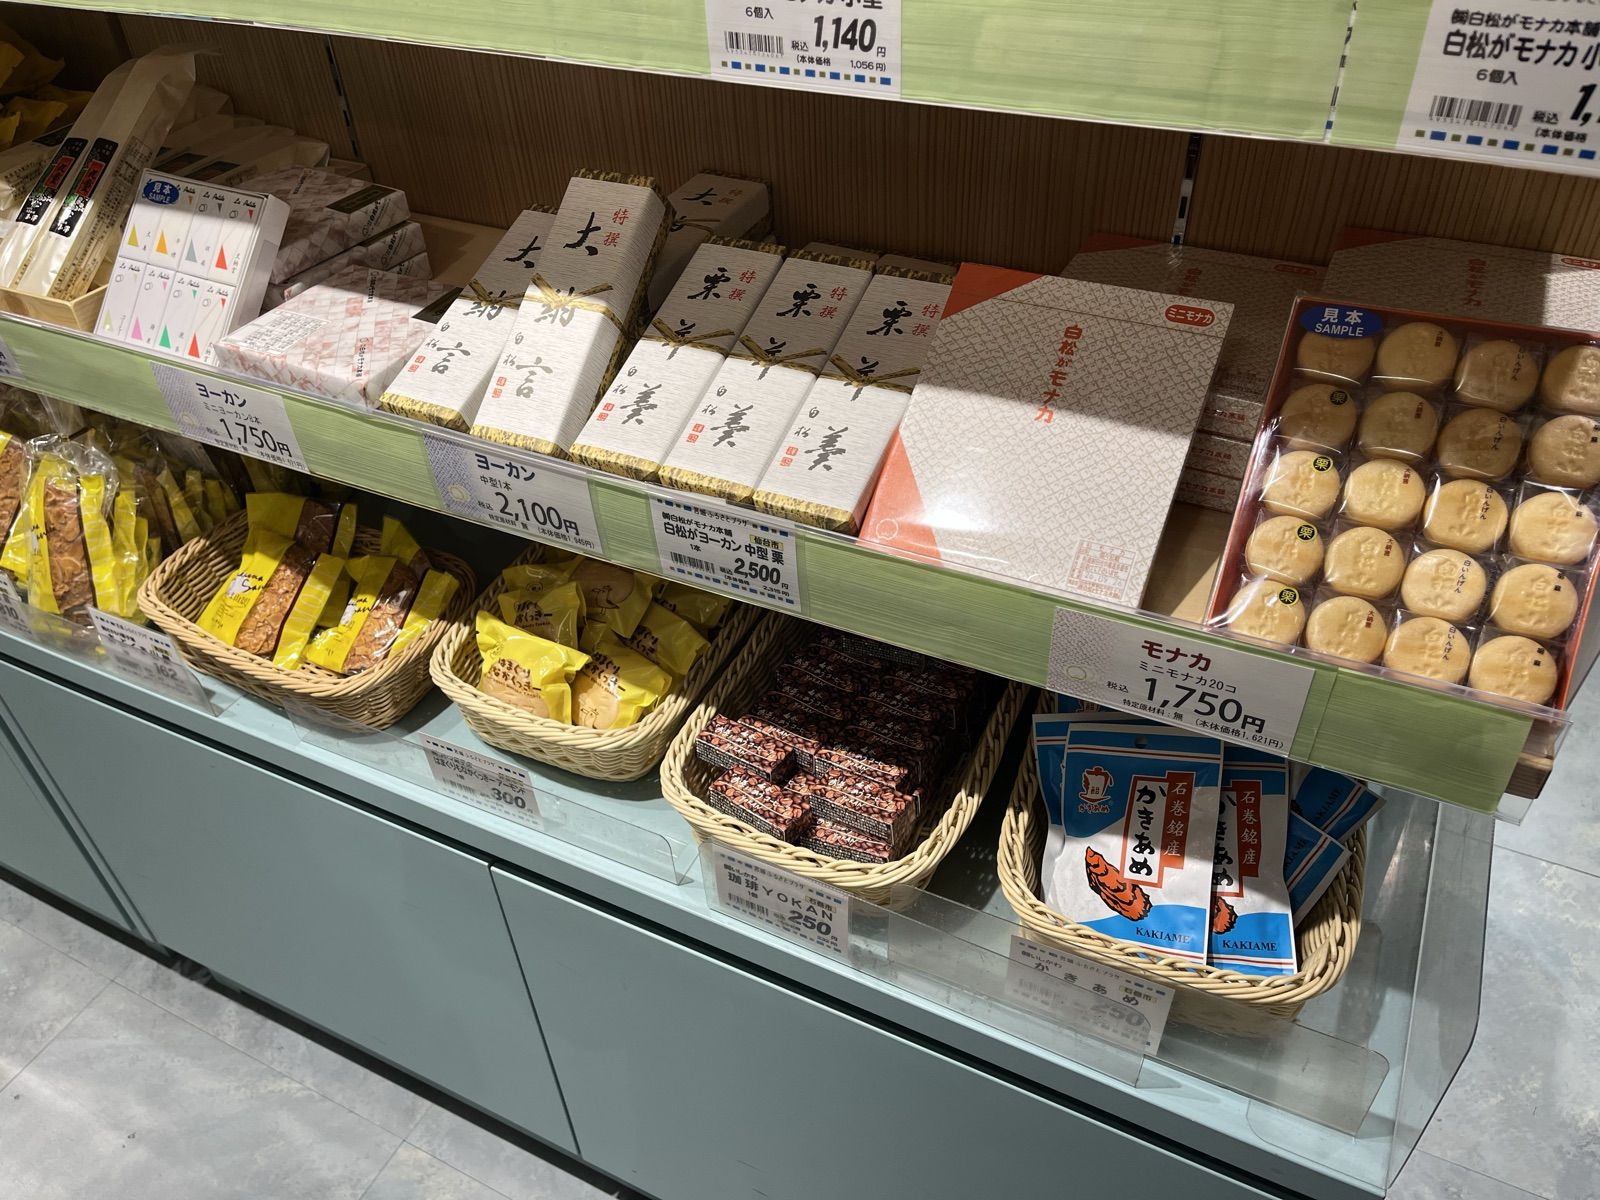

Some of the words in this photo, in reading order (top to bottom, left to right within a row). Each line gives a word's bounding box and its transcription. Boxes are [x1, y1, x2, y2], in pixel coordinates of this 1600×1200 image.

[745, 7, 774, 20] 6個入
[791, 41, 809, 52] 税込
[1476, 68, 1518, 86] 6個入
[149, 193, 171, 204] SAMPLE
[153, 183, 172, 195] 見本
[603, 208, 629, 248] 特撰
[728, 269, 757, 302] 特撰
[819, 285, 848, 320] 特撰
[1322, 307, 1363, 325] 見本
[912, 302, 941, 338] 特撰
[1167, 307, 1214, 326] ミニモナカ
[1315, 323, 1364, 337] SAMPLE
[1033, 324, 1083, 424] 白松がモナカ
[195, 382, 247, 408] ヨーカン
[219, 418, 292, 458] 1,750円
[475, 453, 536, 482] ヨーカン
[1314, 456, 1329, 470] 栗
[480, 475, 513, 491] 中型1本
[477, 500, 494, 511] 税込
[495, 491, 580, 536] 2,100円
[1479, 486, 1494, 520] 白いんげん
[754, 536, 779, 549] 仙台市
[1299, 525, 1314, 540] 栗
[690, 543, 702, 552] 1本
[1455, 559, 1472, 594] 白いんげん
[1281, 588, 1295, 604] 栗
[1141, 639, 1211, 672] モナカ
[1443, 626, 1457, 661] 白いんげん
[1139, 660, 1237, 694] ミニモナカ20コ
[1106, 680, 1129, 693] 税込
[1144, 676, 1266, 734] 1,750円
[1128, 779, 1167, 877] かきあめ
[1164, 781, 1189, 858] 石巻銘産
[1241, 790, 1259, 866] 石巻銘産
[1135, 926, 1191, 944] KAKIAME
[1222, 938, 1278, 952] KAKIAME
